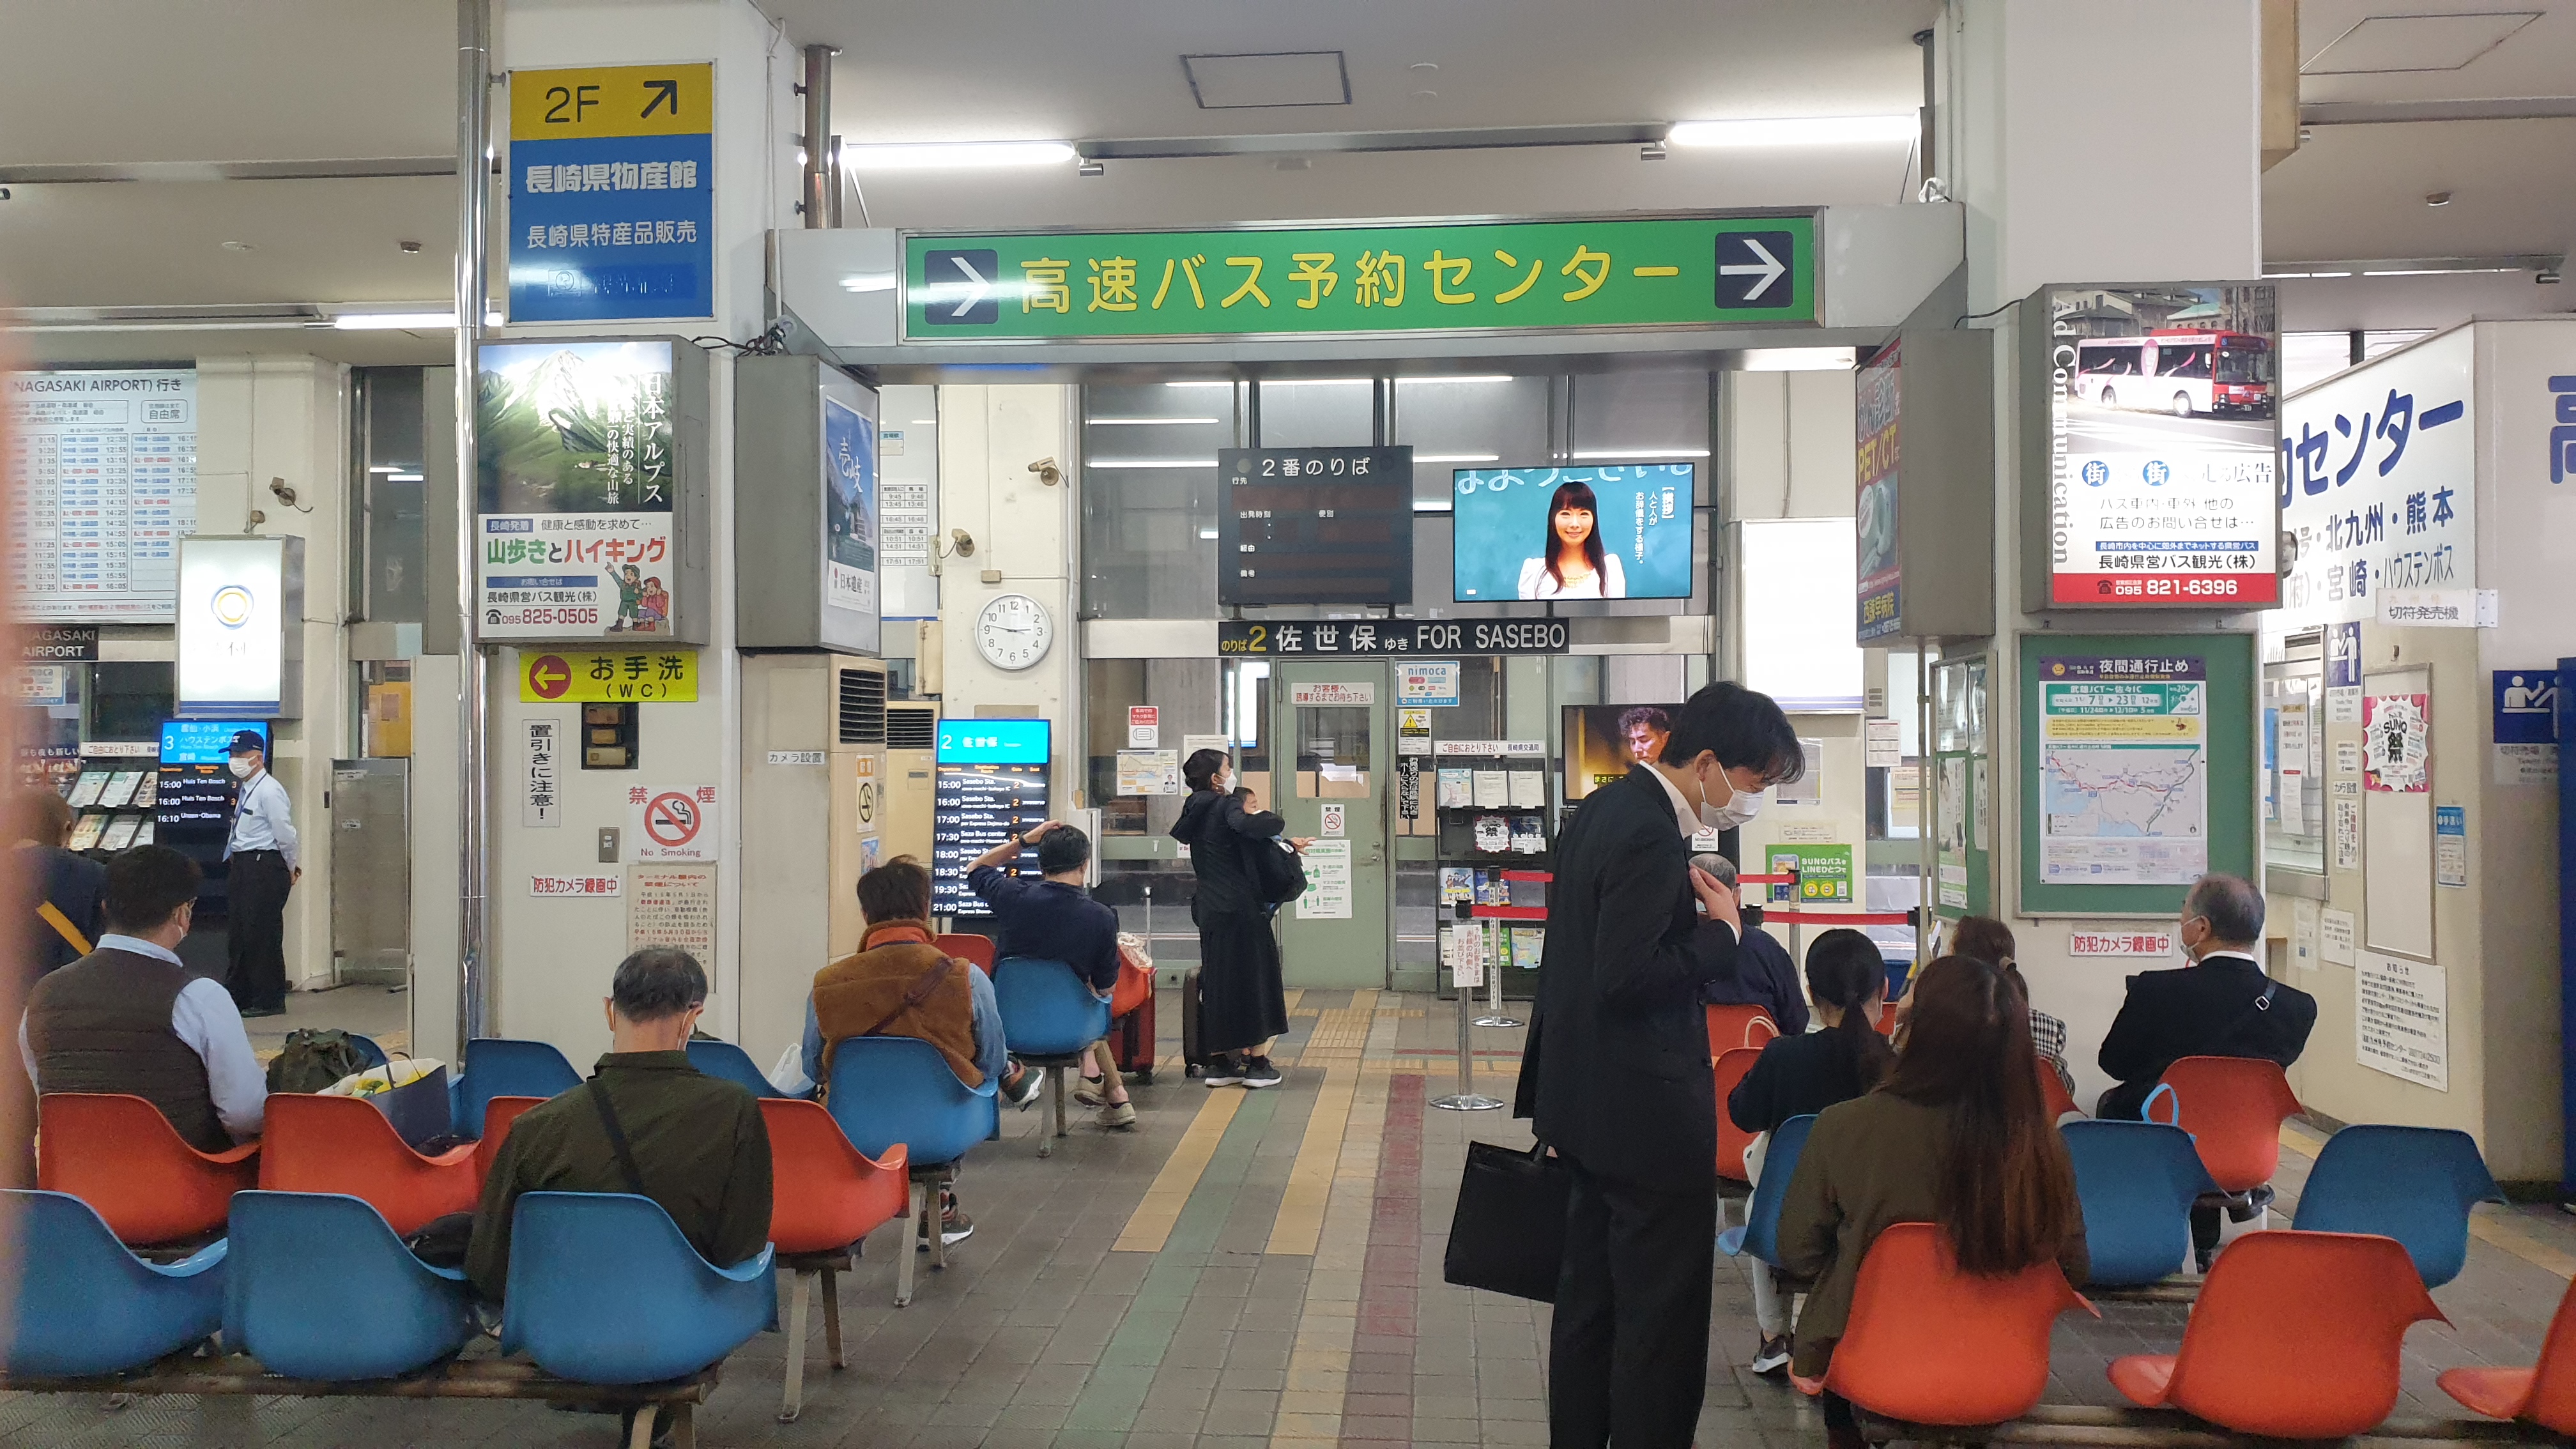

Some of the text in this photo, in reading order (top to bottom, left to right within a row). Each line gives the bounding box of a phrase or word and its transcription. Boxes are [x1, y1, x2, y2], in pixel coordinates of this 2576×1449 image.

[545, 85, 600, 123] 2F
[526, 160, 697, 193] 長崎県物産館
[527, 220, 697, 249] 長崎県特産品販売
[1020, 245, 1679, 314] 高速バス予約センター
[13, 378, 181, 392] NAGASAKI AIRPORT) 行き
[149, 410, 180, 420] 自由席
[622, 396, 634, 484] と実績のある
[642, 374, 666, 503] 日本アルプス
[607, 404, 619, 505] 第一の快適な山旅
[1858, 423, 1896, 487] PET/CT
[2053, 344, 2076, 564] Communication
[1261, 457, 1370, 476] 2番のりば
[1648, 491, 1658, 526] 人と人が
[490, 521, 529, 532] 長崎発着
[2295, 485, 2454, 558] 号・北九州・熊本
[487, 536, 666, 564] 山歩きとハイキング
[2099, 555, 2255, 569] 長崎県営バス観光(株)
[521, 577, 562, 586] お問い合せは
[840, 573, 863, 594] 日本遺産
[2115, 586, 2142, 595] 095
[2147, 580, 2238, 595] 821-6396
[487, 591, 597, 602] 長崎県営バス観光(株)
[998, 604, 1006, 613] 11
[1010, 601, 1018, 610] 12
[1026, 605, 1029, 613] 1
[502, 608, 597, 624] 095 825-0505
[988, 613, 997, 622] 10
[1034, 614, 1039, 623] 2
[2389, 606, 2458, 620] 切符発売機
[29, 630, 95, 641] AGASAKI
[984, 625, 990, 634] 9
[1037, 627, 1043, 636] 3
[988, 639, 995, 647] 8
[1032, 640, 1038, 648] 4
[1221, 624, 1565, 652] のりば 2 佐世保 ゆき FOR SASEBO
[23, 646, 84, 657] AIRPORT
[997, 648, 1003, 657] 7
[1009, 652, 1016, 661] 6
[1023, 649, 1029, 658] 5
[590, 656, 684, 680] お手洗
[1408, 665, 1446, 675] nimoca
[2099, 659, 2188, 673] 夜間通行止め
[606, 683, 667, 698] (WC)
[1313, 684, 1348, 693] お客様へ
[1296, 693, 1372, 702] 誘導するまでお待ち下さい
[2089, 695, 2128, 704] 7 23
[2384, 719, 2407, 734] SUNQ
[164, 735, 174, 750] 3
[941, 735, 952, 749] 2
[1443, 744, 1498, 753] ご自由におとり下さい
[769, 753, 822, 763] カメラ設置
[530, 724, 553, 820] 置引きに注意!
[158, 797, 180, 806] 16:00
[157, 815, 180, 823] 16:10
[640, 848, 702, 858] No Smoking
[533, 877, 617, 894] 防犯カメラ録画中
[2074, 936, 2168, 953] 防犯カメラ録画中
